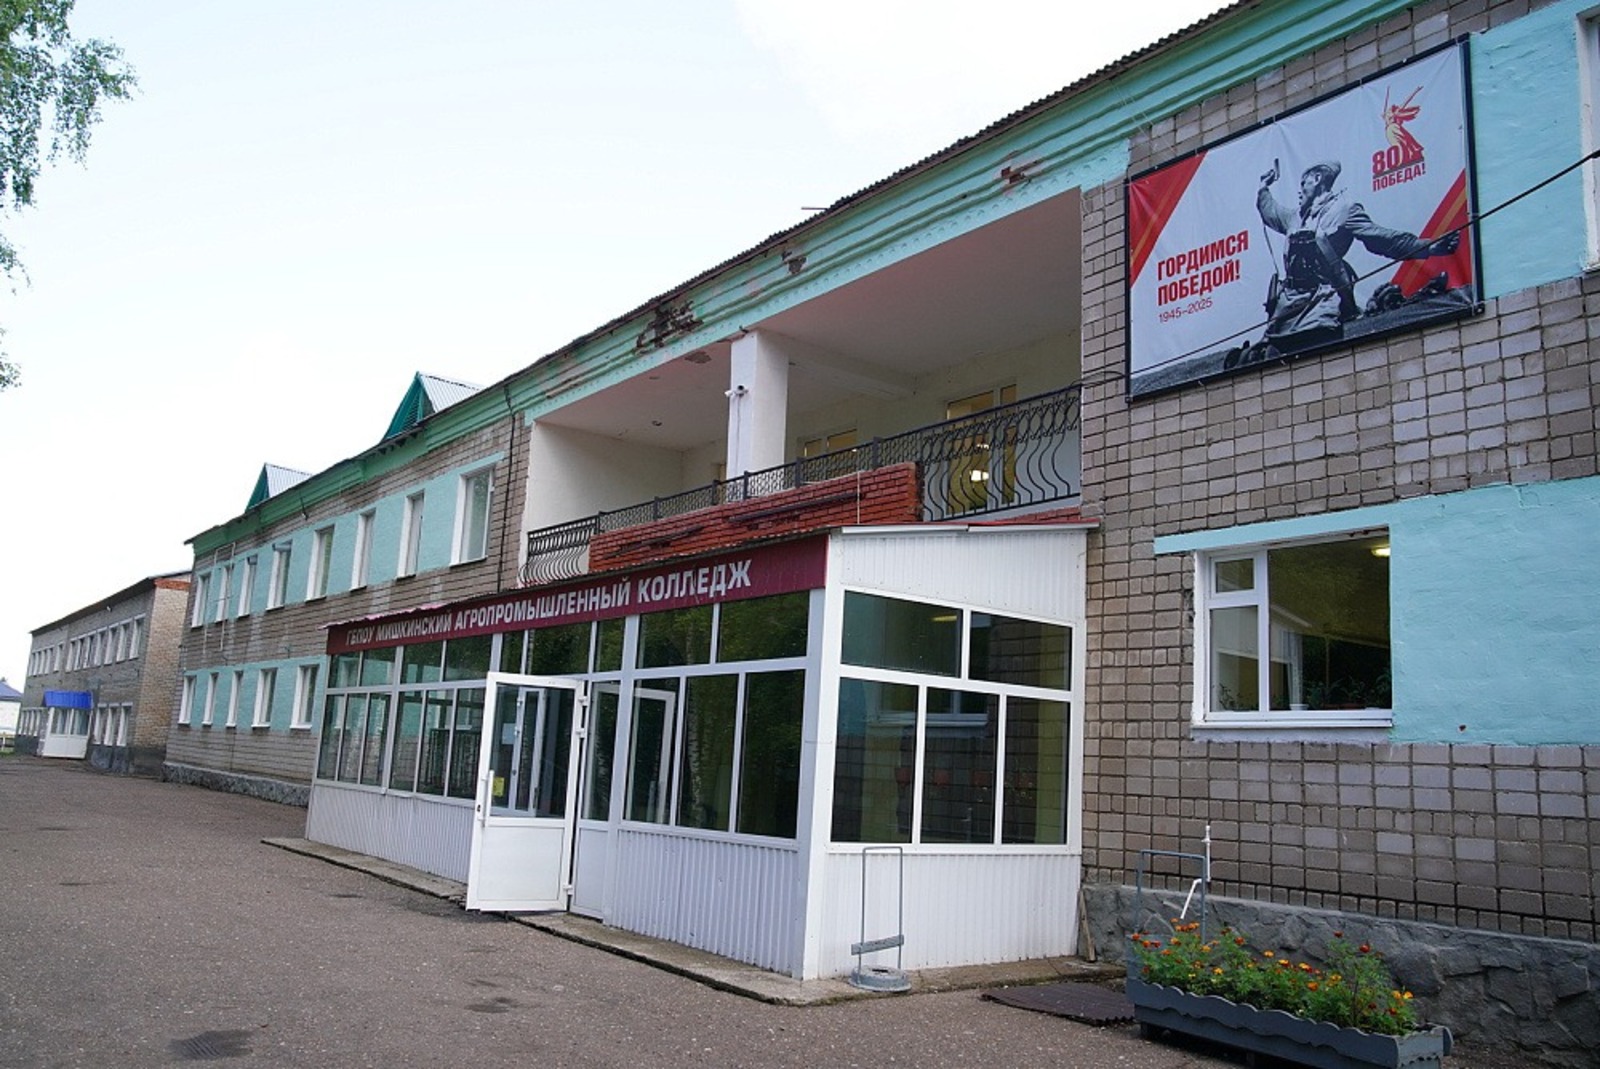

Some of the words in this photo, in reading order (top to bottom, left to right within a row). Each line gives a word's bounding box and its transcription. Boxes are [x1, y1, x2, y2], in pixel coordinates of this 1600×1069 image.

[1372, 144, 1400, 175] 80
[1372, 162, 1426, 192] ПОБЕДА!
[1157, 230, 1249, 281] ГОРДИМСЯ
[1157, 259, 1240, 306] ПОБЕДОЙ!
[375, 609, 452, 641] МИШКИНСКИЙ
[454, 576, 631, 631] АГРОПРОМЫШЛЕННЫЙ
[637, 559, 752, 603] КОЛЛЕДЖ
